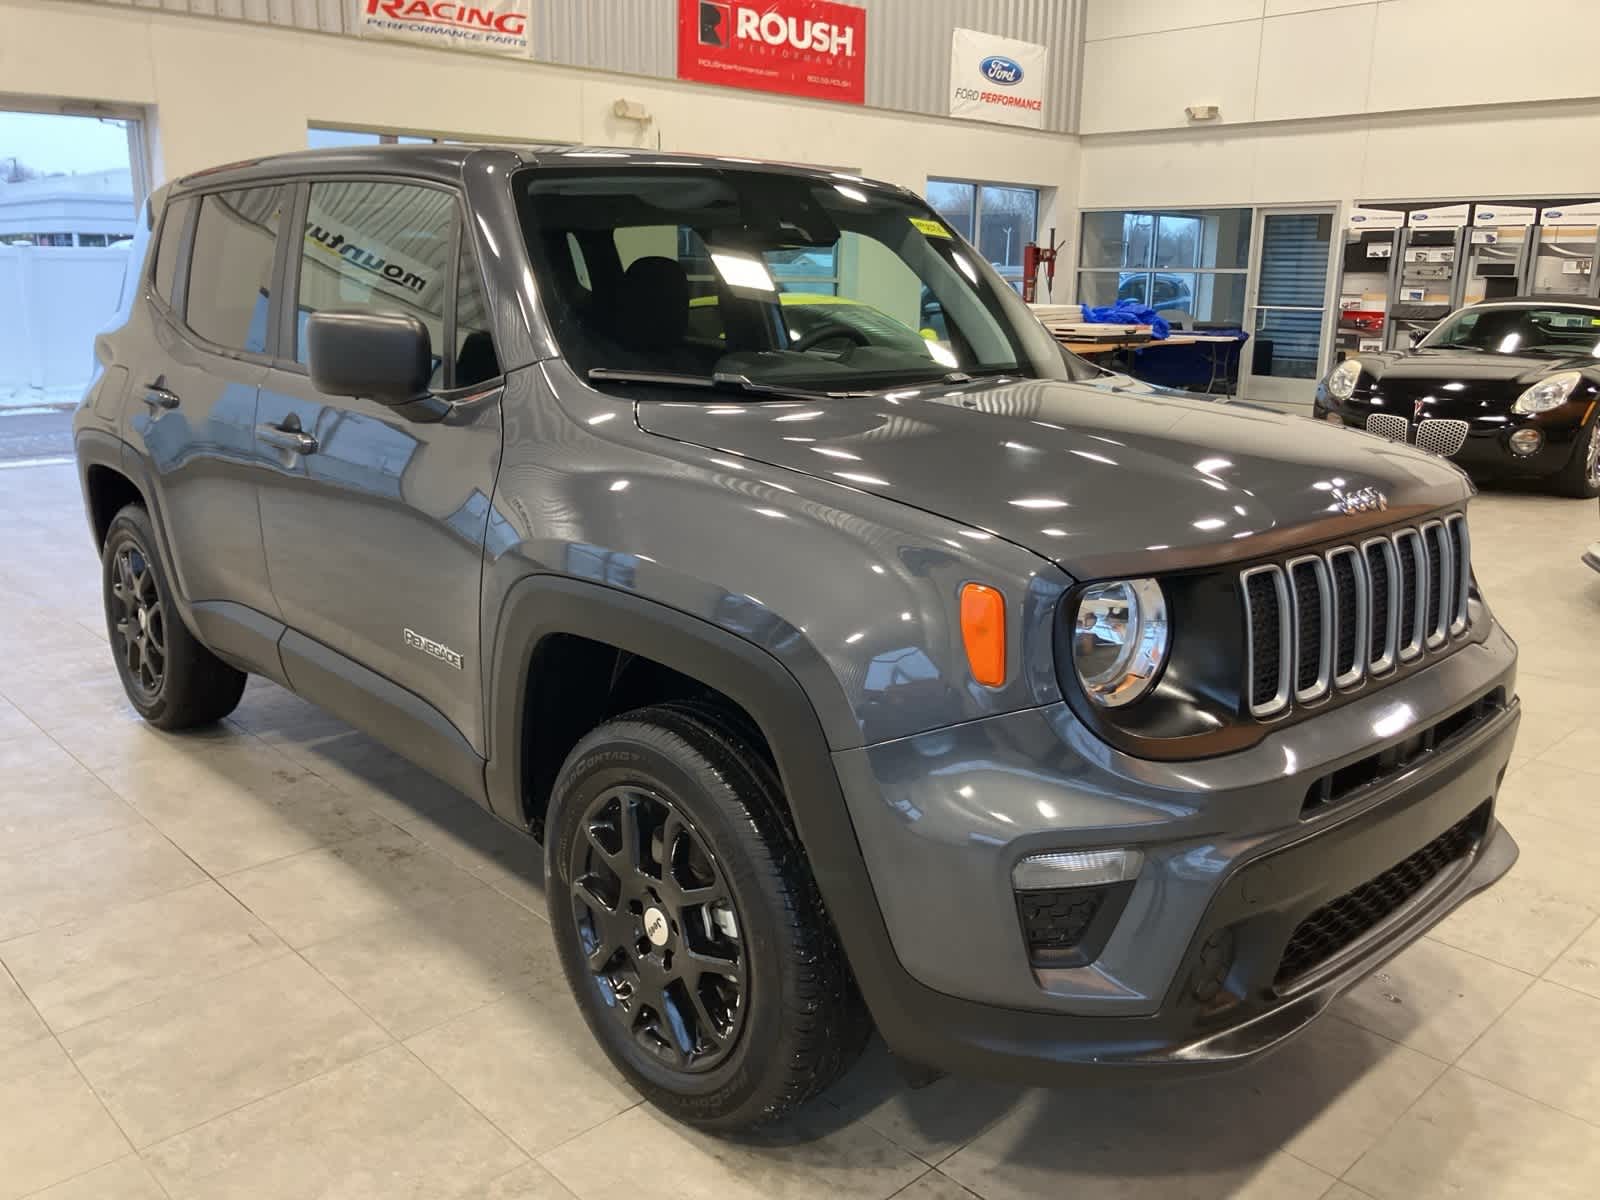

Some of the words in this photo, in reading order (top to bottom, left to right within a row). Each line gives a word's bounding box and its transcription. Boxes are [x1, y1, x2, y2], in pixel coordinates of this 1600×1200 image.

[366, 0, 527, 35] RACING
[737, 7, 854, 57] ROUSH
[367, 18, 482, 41] PERFORMANCE
[486, 36, 528, 47] PARTS
[988, 59, 1016, 82] Ford
[955, 87, 979, 101] FORD
[980, 92, 1042, 111] PERFORMANCE
